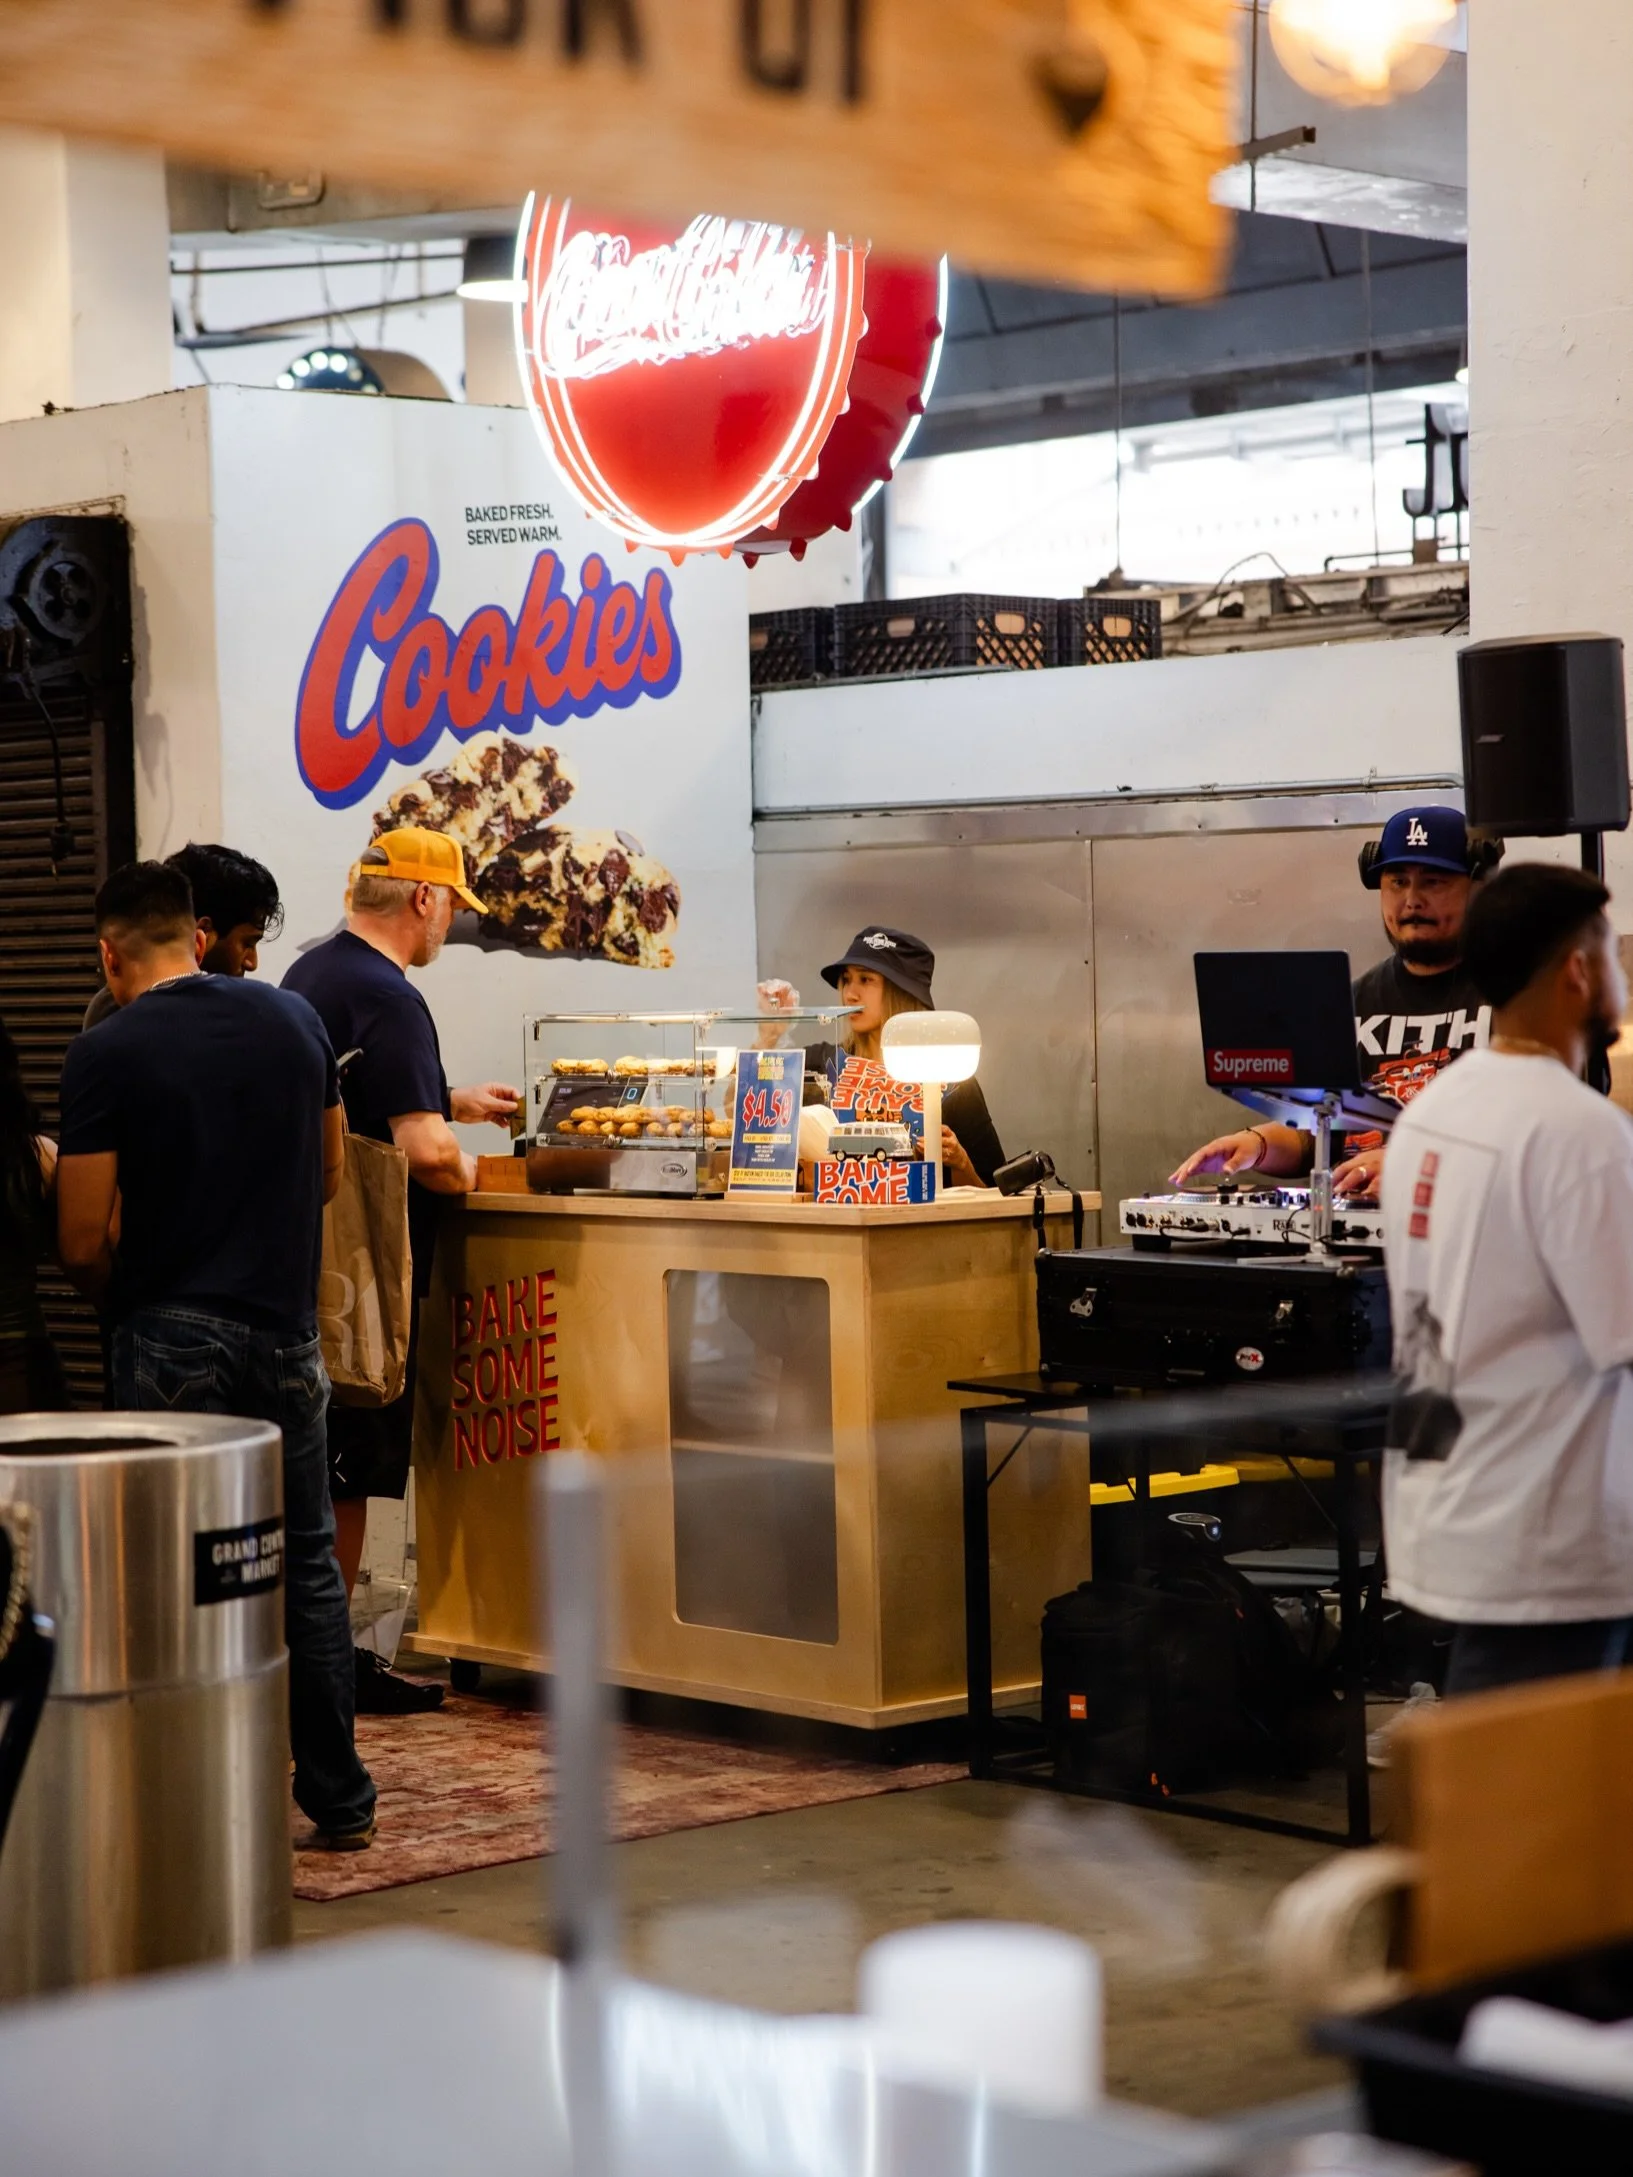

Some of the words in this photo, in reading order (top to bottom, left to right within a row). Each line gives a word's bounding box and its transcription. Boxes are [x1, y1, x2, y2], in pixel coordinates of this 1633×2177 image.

[465, 506, 508, 523] BAKED
[509, 503, 554, 520] FRESH.
[467, 528, 517, 545] SERVED
[518, 525, 563, 543] WARM.
[295, 516, 683, 811] Cookies
[1406, 817, 1428, 846] LA
[1354, 1005, 1493, 1056] KITH
[1213, 1051, 1289, 1079] Supreme
[743, 1086, 793, 1131] $4.50
[452, 1269, 558, 1349] BAKE
[452, 1332, 559, 1411] SOME
[454, 1394, 560, 1472] NOISE
[212, 1537, 258, 1566] GRAND
